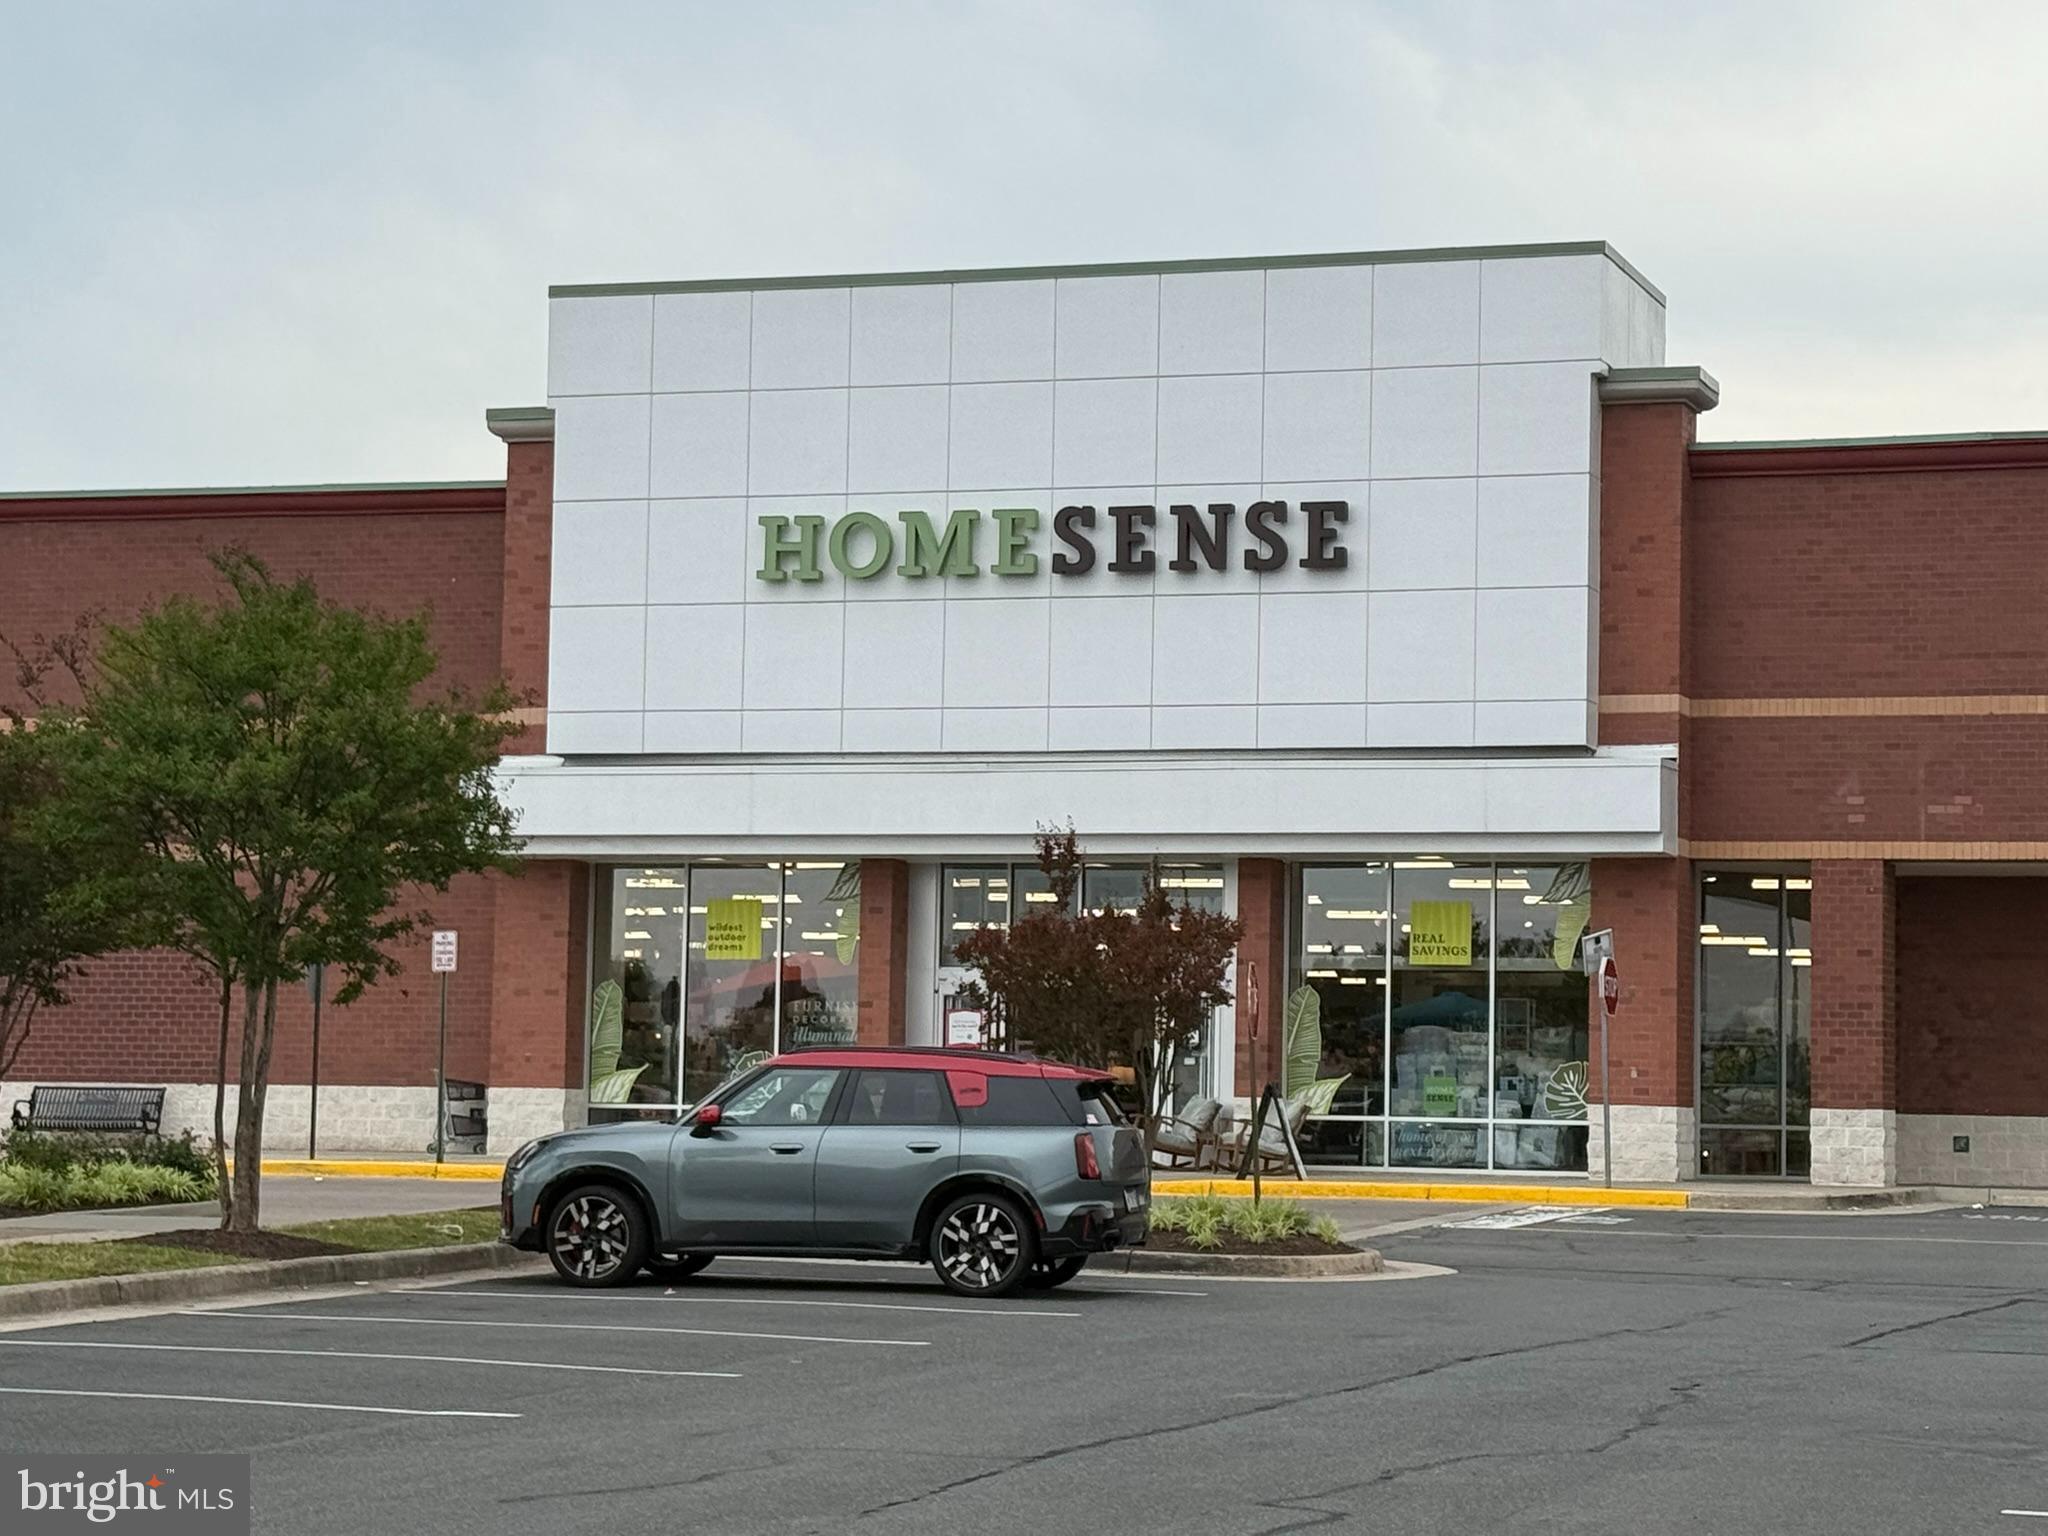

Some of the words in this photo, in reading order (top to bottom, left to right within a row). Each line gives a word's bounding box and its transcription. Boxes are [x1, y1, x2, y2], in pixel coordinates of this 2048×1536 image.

[708, 923, 743, 931] wildest
[1413, 934, 1445, 943] REAL
[708, 943, 743, 951] dreams
[1412, 946, 1468, 956] SAVINGS
